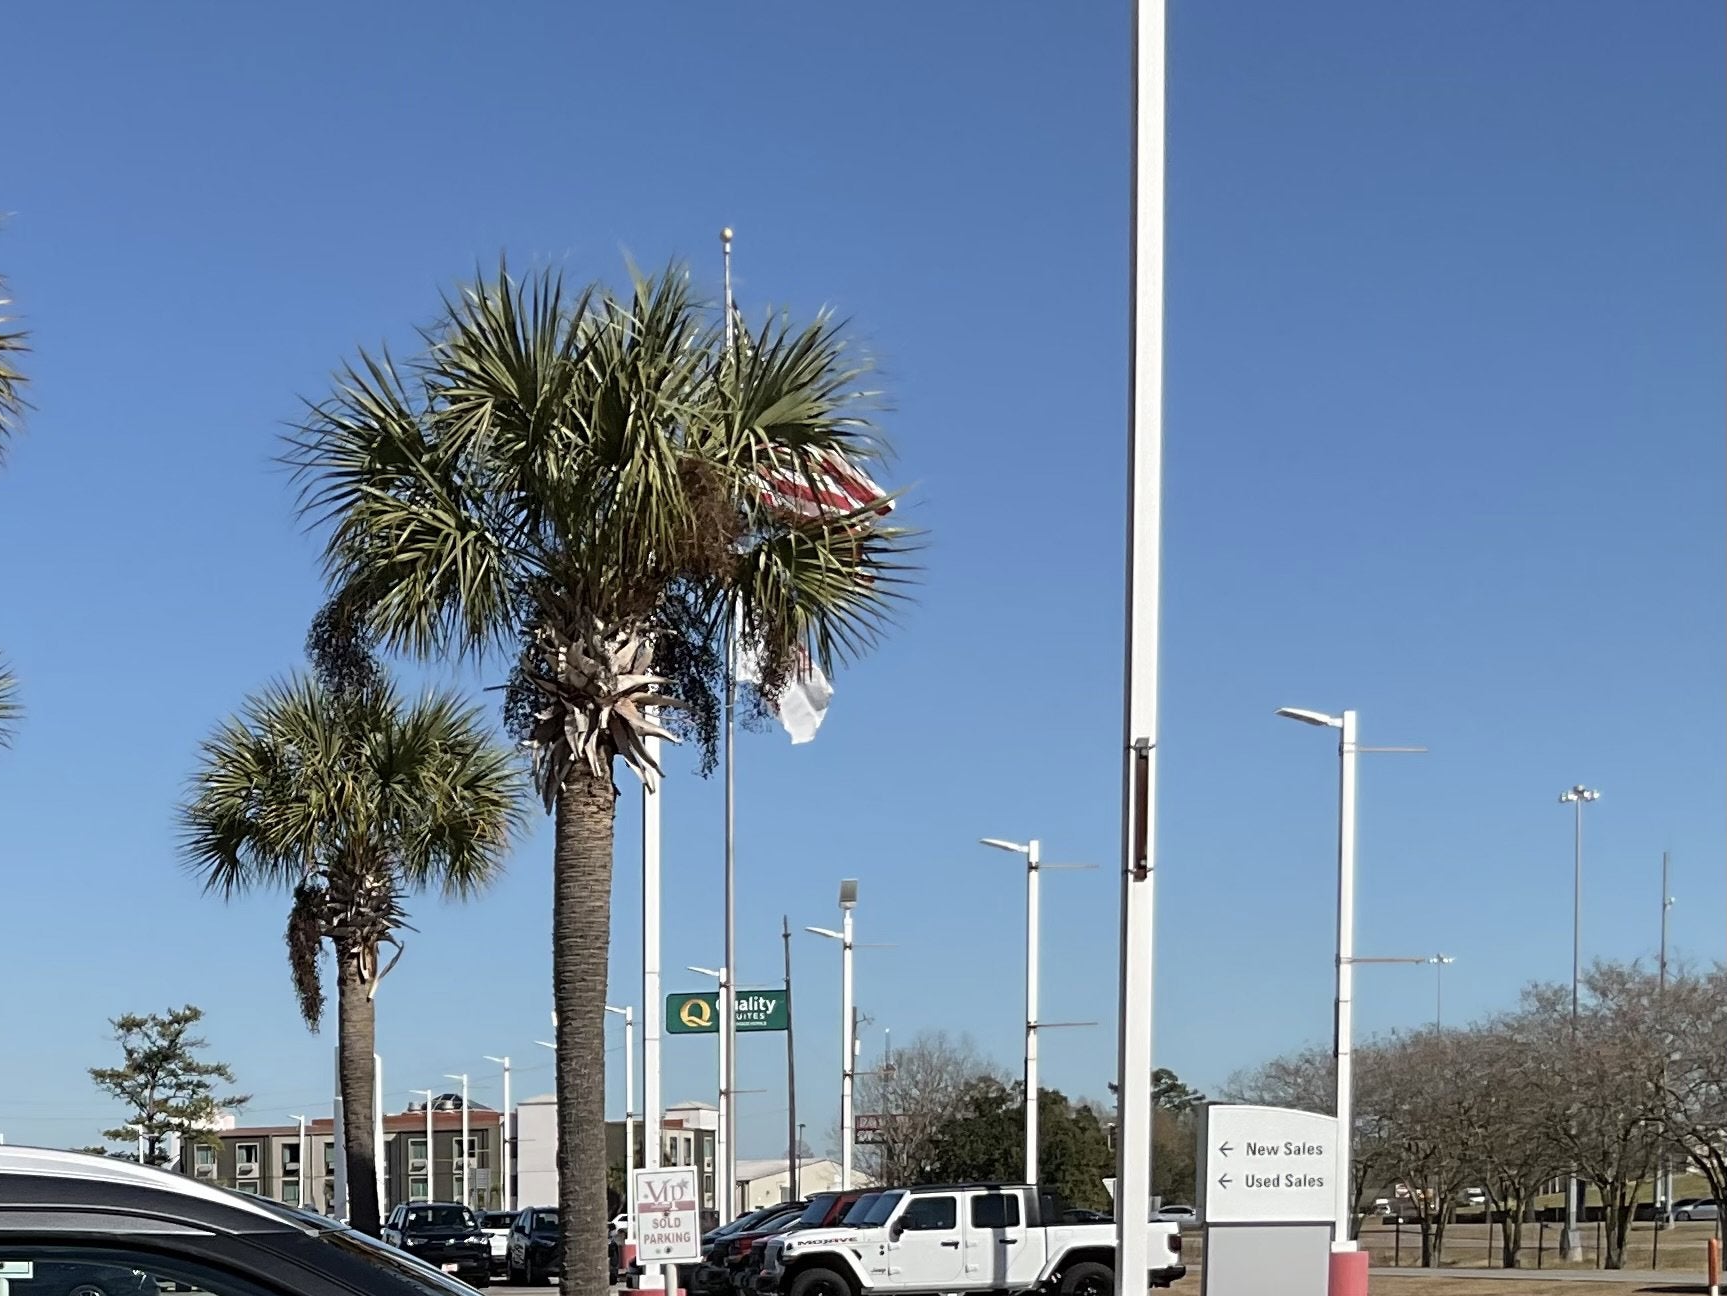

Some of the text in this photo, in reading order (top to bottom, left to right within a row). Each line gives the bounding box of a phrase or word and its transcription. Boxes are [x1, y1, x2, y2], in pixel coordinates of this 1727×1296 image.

[715, 996, 777, 1014] ality
[735, 1012, 766, 1021] UITES
[1246, 1141, 1323, 1156] New Sales
[1245, 1173, 1324, 1188] Used Sales
[652, 1217, 681, 1229] SOLD
[644, 1232, 691, 1245] PARKING
[797, 1236, 858, 1247] MOJAVE
